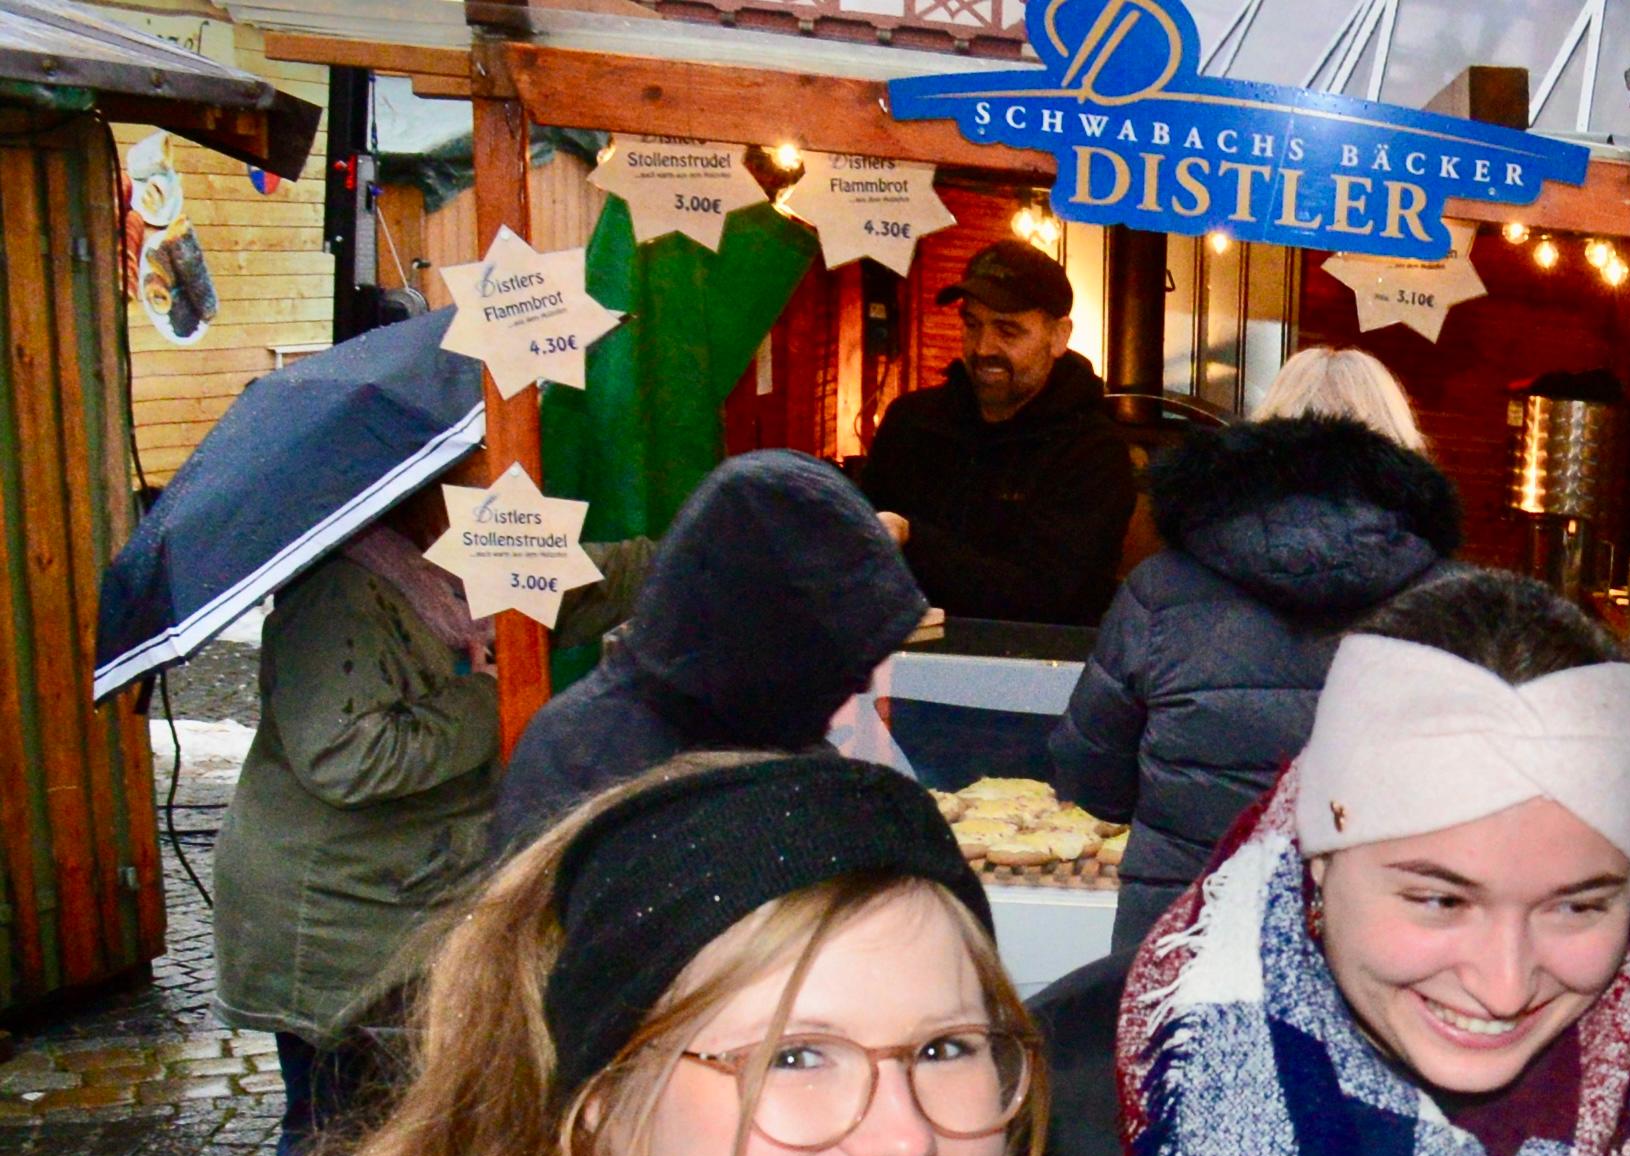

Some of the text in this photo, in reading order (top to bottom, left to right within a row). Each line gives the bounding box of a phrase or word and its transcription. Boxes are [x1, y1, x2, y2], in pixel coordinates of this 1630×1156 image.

[974, 101, 1525, 187] SCHWABACHS BÄCKER
[627, 151, 731, 169] Stollenstrudel
[830, 178, 908, 193] Flammbrot
[1069, 144, 1434, 243] DISTLER
[674, 193, 722, 214] 3.00€
[863, 220, 911, 239] 4.30€
[483, 291, 564, 322] Flammbrot
[1396, 290, 1435, 308] 3.10€
[529, 334, 577, 355] 4.30€
[463, 532, 568, 549] Stollenstrudel
[510, 573, 558, 592] 3.00€
